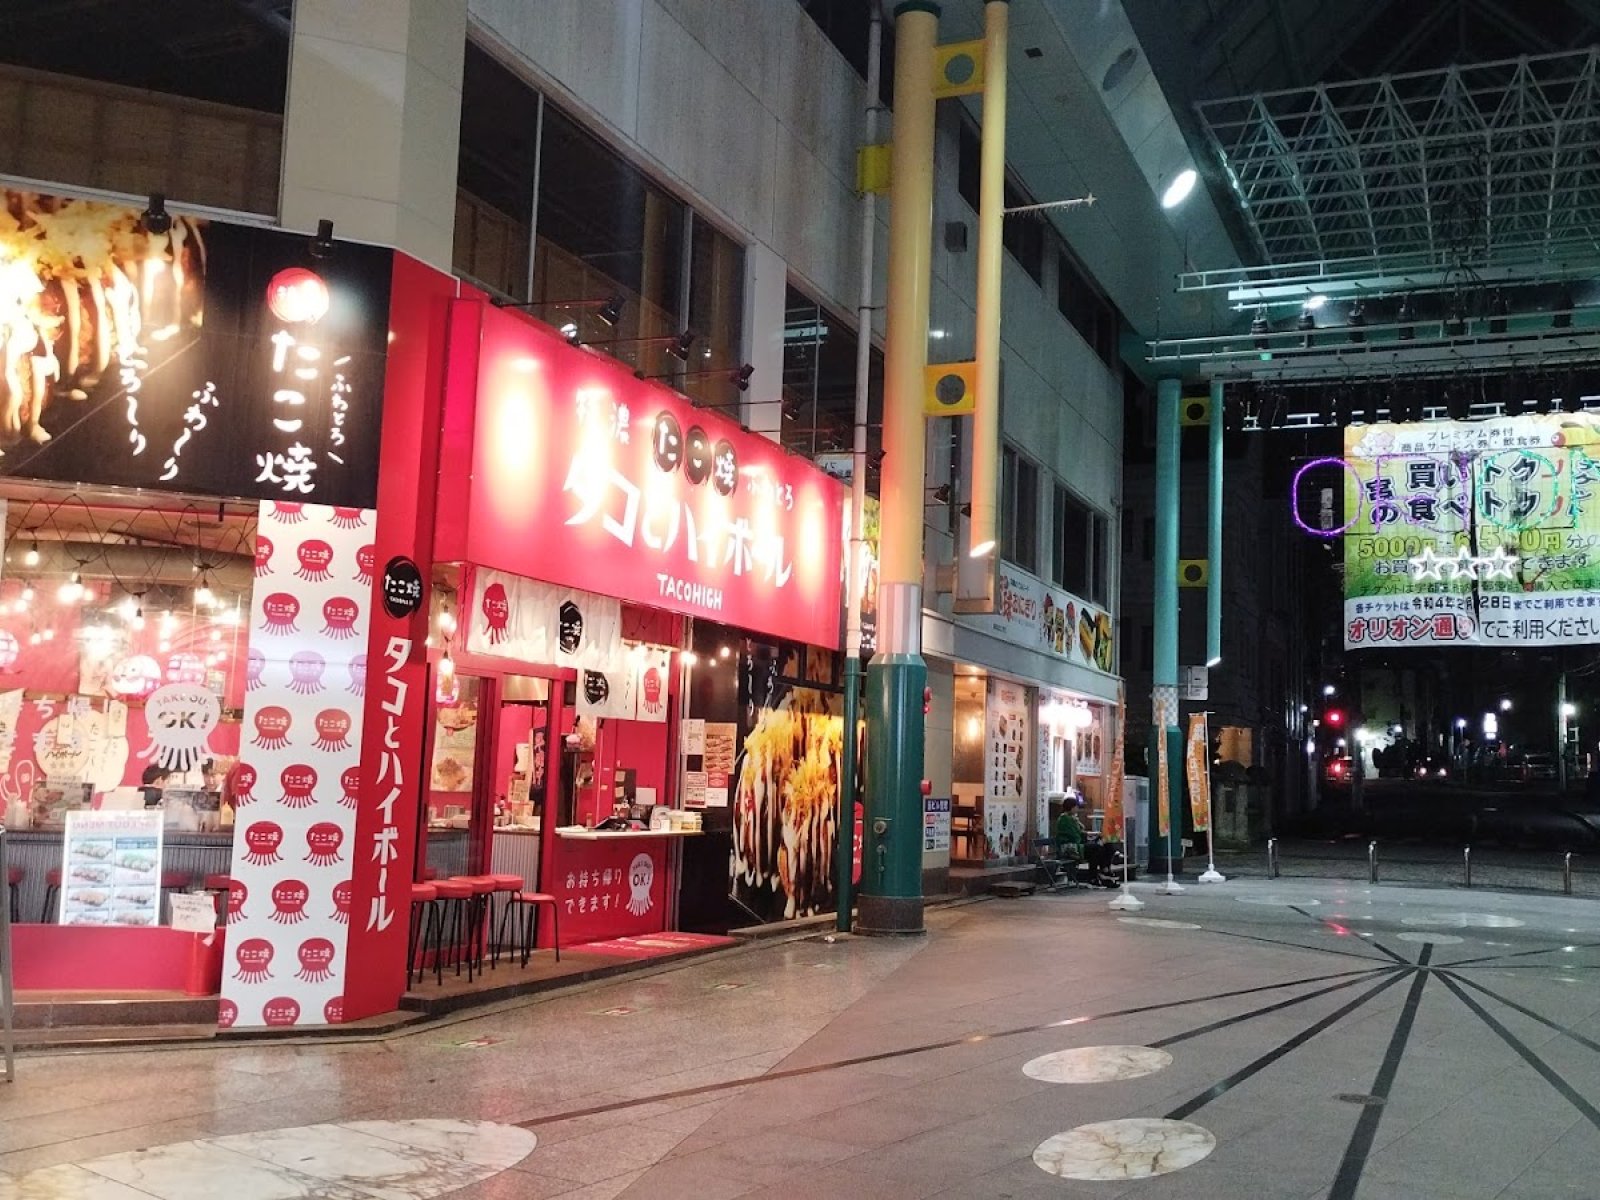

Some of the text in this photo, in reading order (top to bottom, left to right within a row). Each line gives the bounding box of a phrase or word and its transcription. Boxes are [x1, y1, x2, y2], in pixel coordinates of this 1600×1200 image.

[256, 330, 321, 494] たこ焼
[658, 419, 737, 488] たこ焼
[300, 548, 331, 560] たこ焼
[384, 574, 421, 599] たこ焼
[656, 572, 723, 610] TACOHIGH
[267, 602, 297, 613] たこ焼
[327, 606, 355, 617] たこ焼
[258, 715, 288, 727] たこ焼
[319, 718, 348, 729] たこ焼
[284, 774, 314, 785] たこ焼
[366, 636, 414, 933] タコとハイボール
[249, 831, 279, 842] たこ焼
[310, 832, 340, 842] たこ焼
[565, 867, 622, 889] お持ち帰り
[275, 889, 305, 900] たこ焼
[240, 948, 270, 959] たこ焼
[301, 948, 331, 958] たこ焼
[267, 1007, 296, 1018] たこ焼
